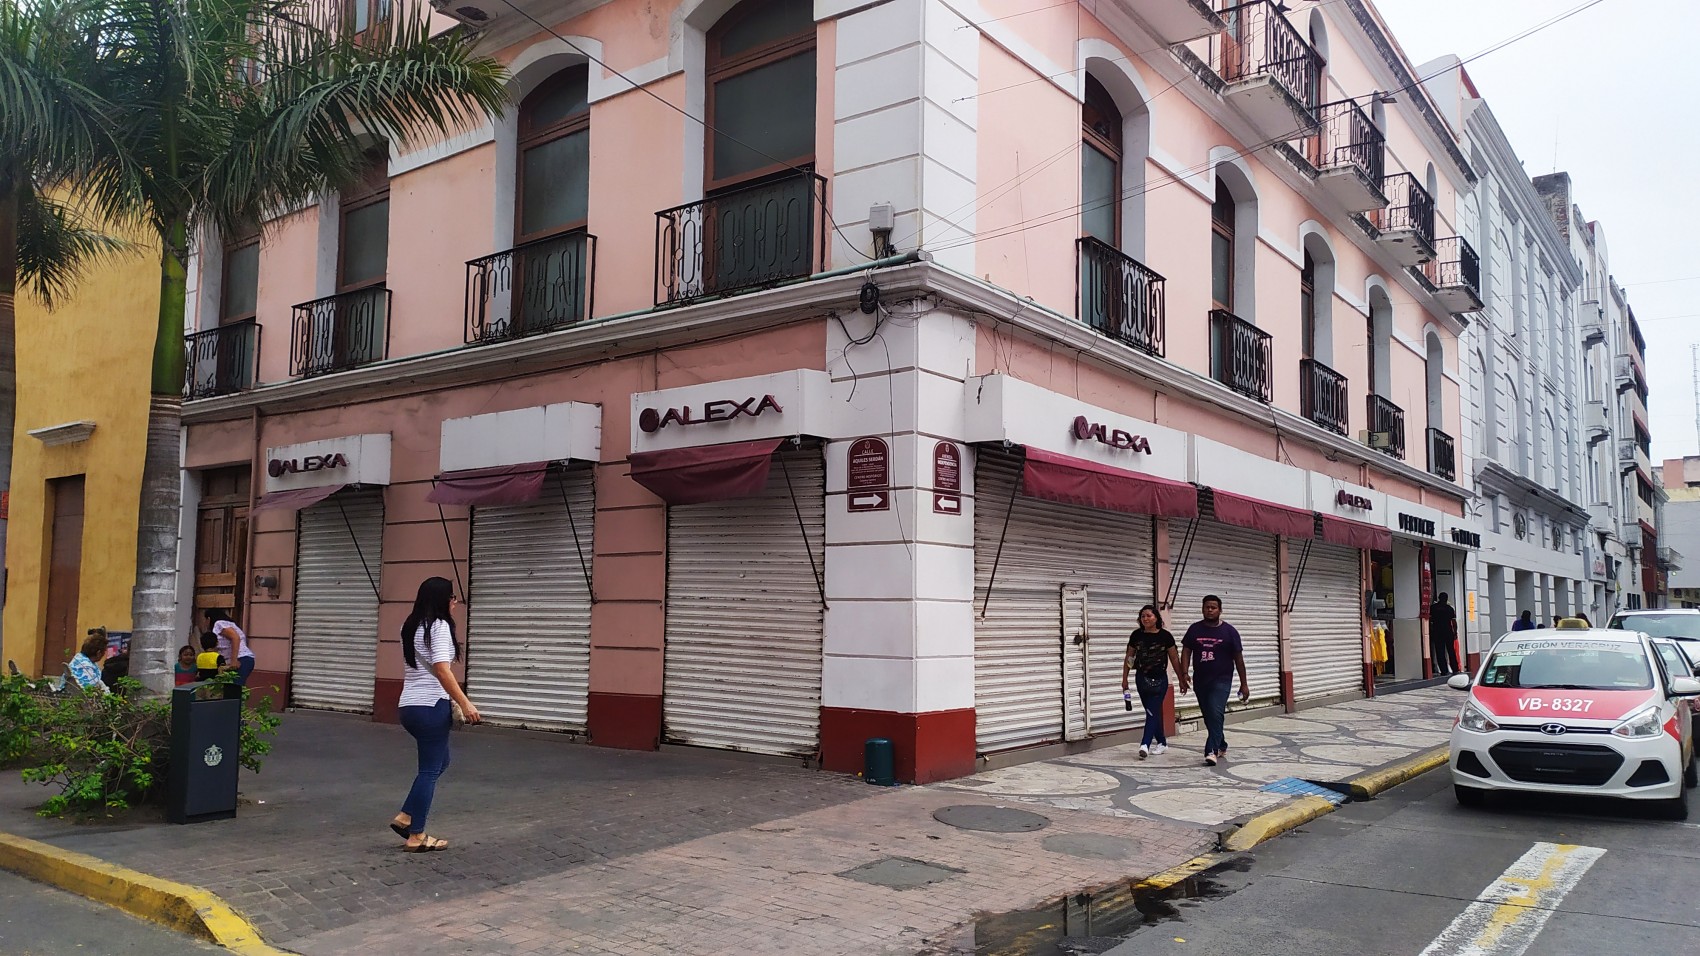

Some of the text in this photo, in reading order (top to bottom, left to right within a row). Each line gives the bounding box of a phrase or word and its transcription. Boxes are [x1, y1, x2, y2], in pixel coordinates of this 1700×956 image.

[659, 394, 783, 428] ALEXA
[1087, 423, 1152, 455] ALEXA
[279, 453, 347, 475] ALEXA
[1517, 641, 1557, 650] REGIÓN
